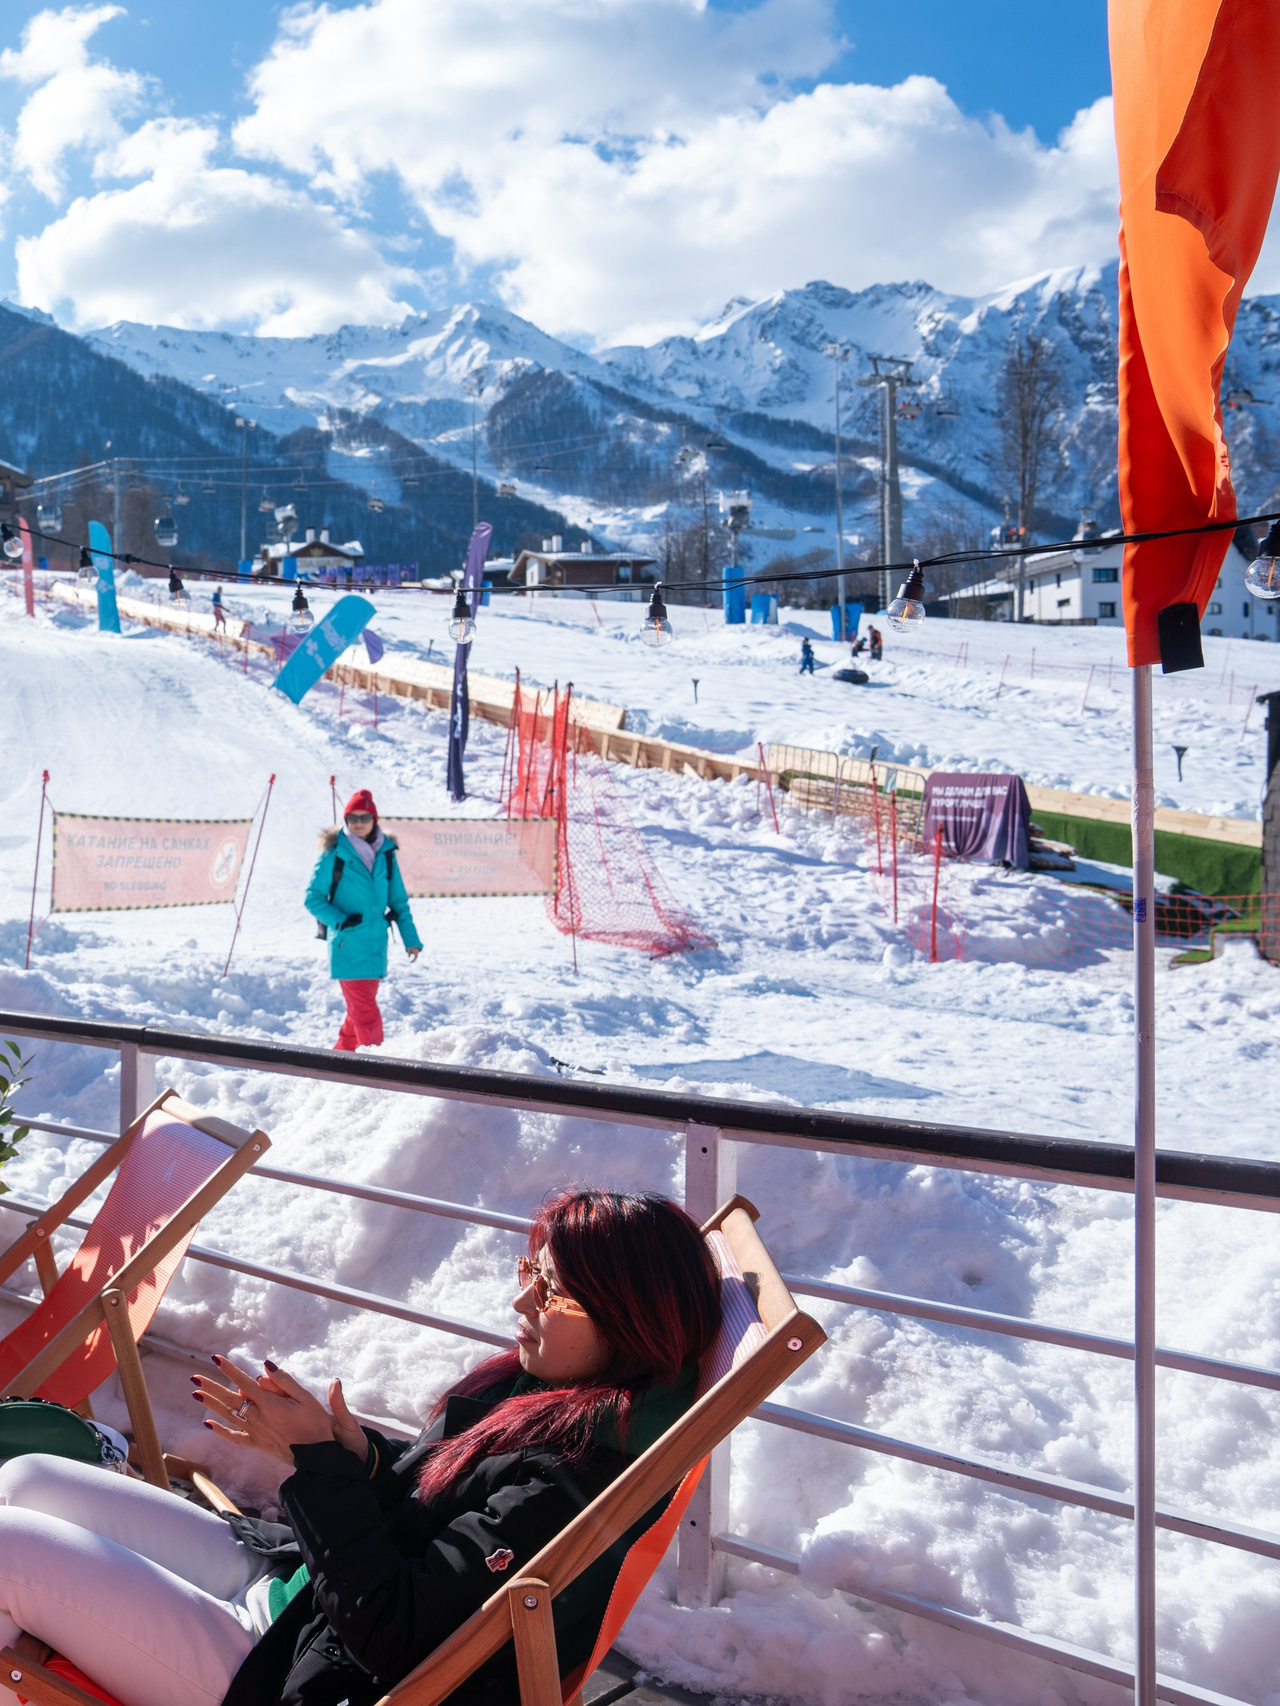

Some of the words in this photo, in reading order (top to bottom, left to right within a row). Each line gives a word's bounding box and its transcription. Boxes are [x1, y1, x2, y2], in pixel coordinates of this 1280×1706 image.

[67, 834, 136, 850] КАТАНИЕ
[140, 837, 158, 850] НА
[162, 837, 211, 850] САНКАХ
[96, 855, 182, 870] ЗАПРЕЩЕНО
[120, 881, 168, 891] SLEDDING
